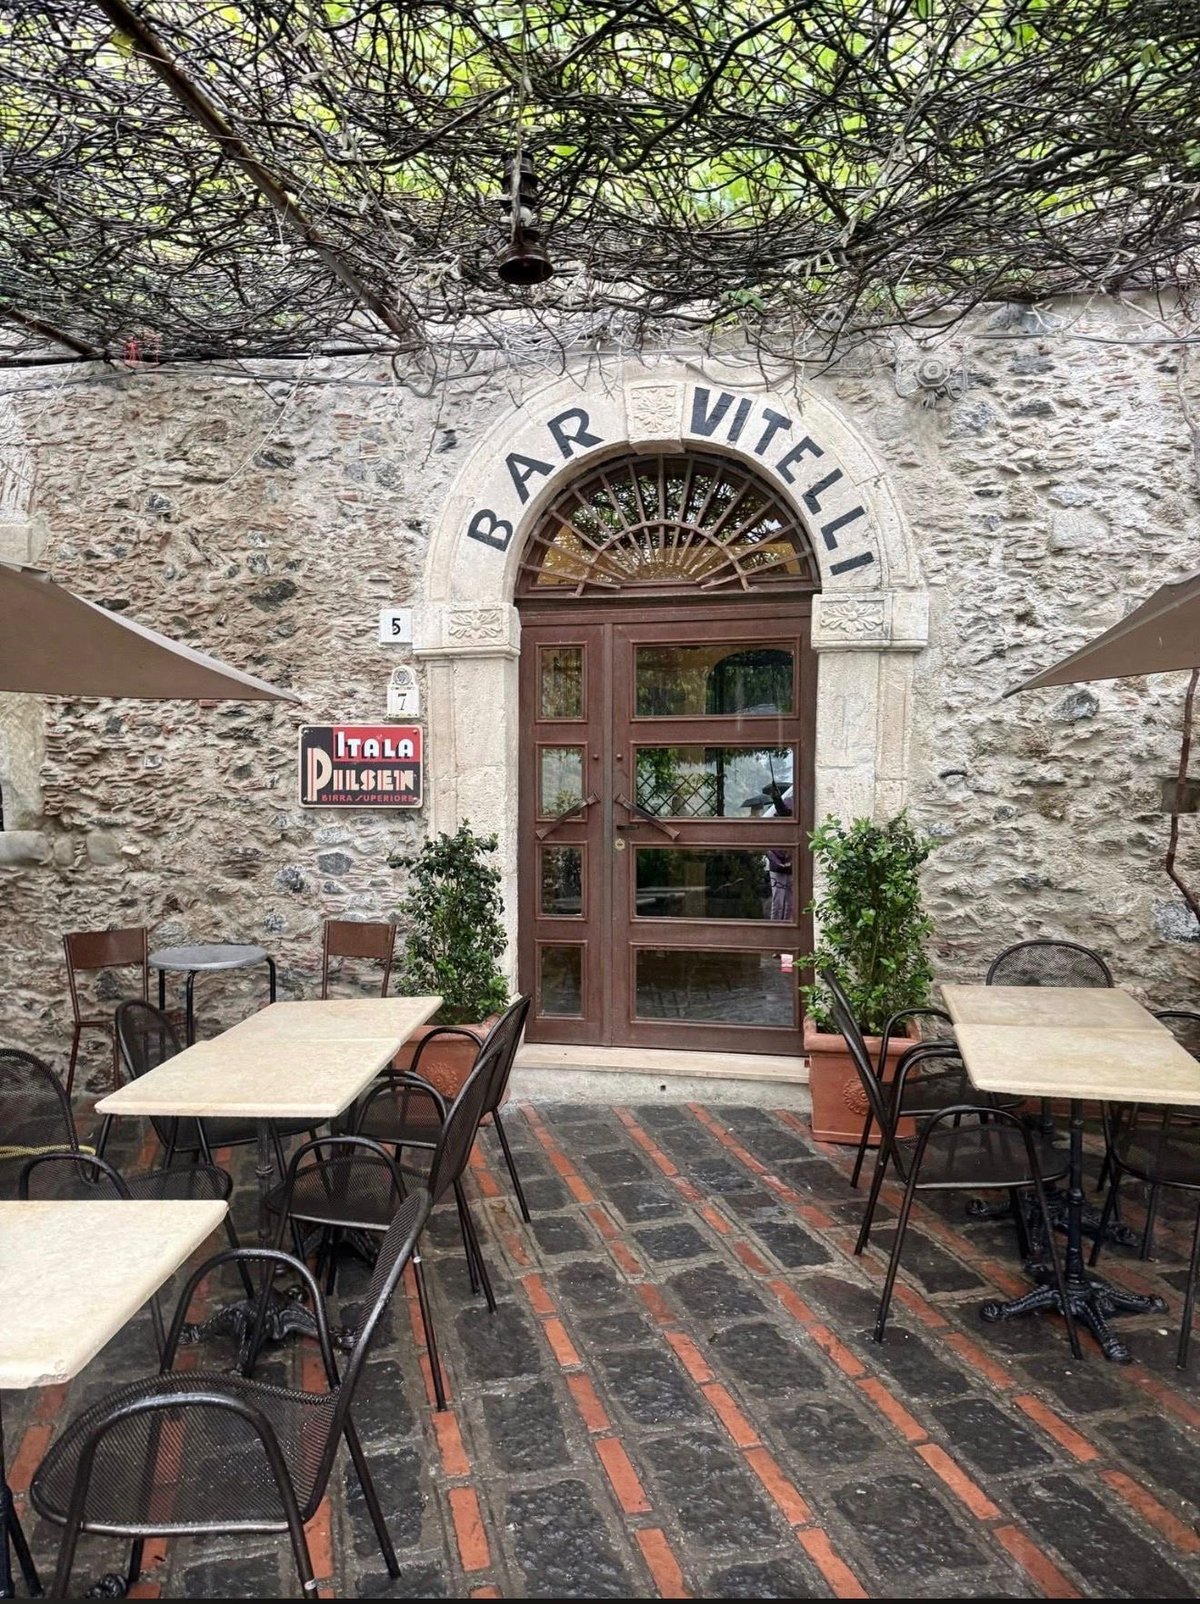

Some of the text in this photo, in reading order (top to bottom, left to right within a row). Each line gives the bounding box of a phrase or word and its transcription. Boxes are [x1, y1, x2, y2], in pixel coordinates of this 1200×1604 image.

[467, 387, 874, 576] BAR VITELLI
[392, 617, 401, 636] 5
[337, 731, 414, 757] ITALA
[307, 747, 414, 801] PILSEN
[321, 794, 353, 802] BIRRA
